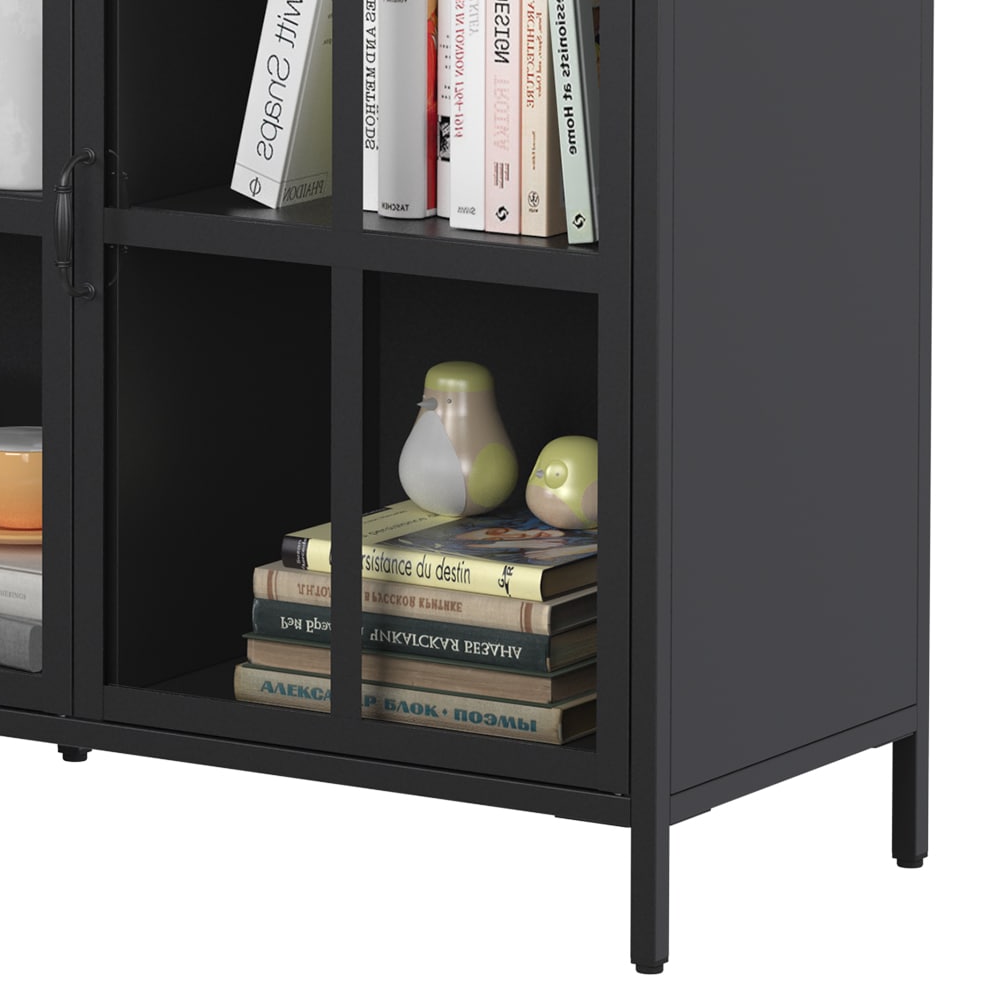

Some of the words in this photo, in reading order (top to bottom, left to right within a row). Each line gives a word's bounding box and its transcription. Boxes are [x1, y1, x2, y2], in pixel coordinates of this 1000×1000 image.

[416, 553, 432, 580] du
[436, 556, 471, 585] destin
[384, 695, 439, 719] БЛОК
[454, 708, 537, 734] ПОЭМЫ
